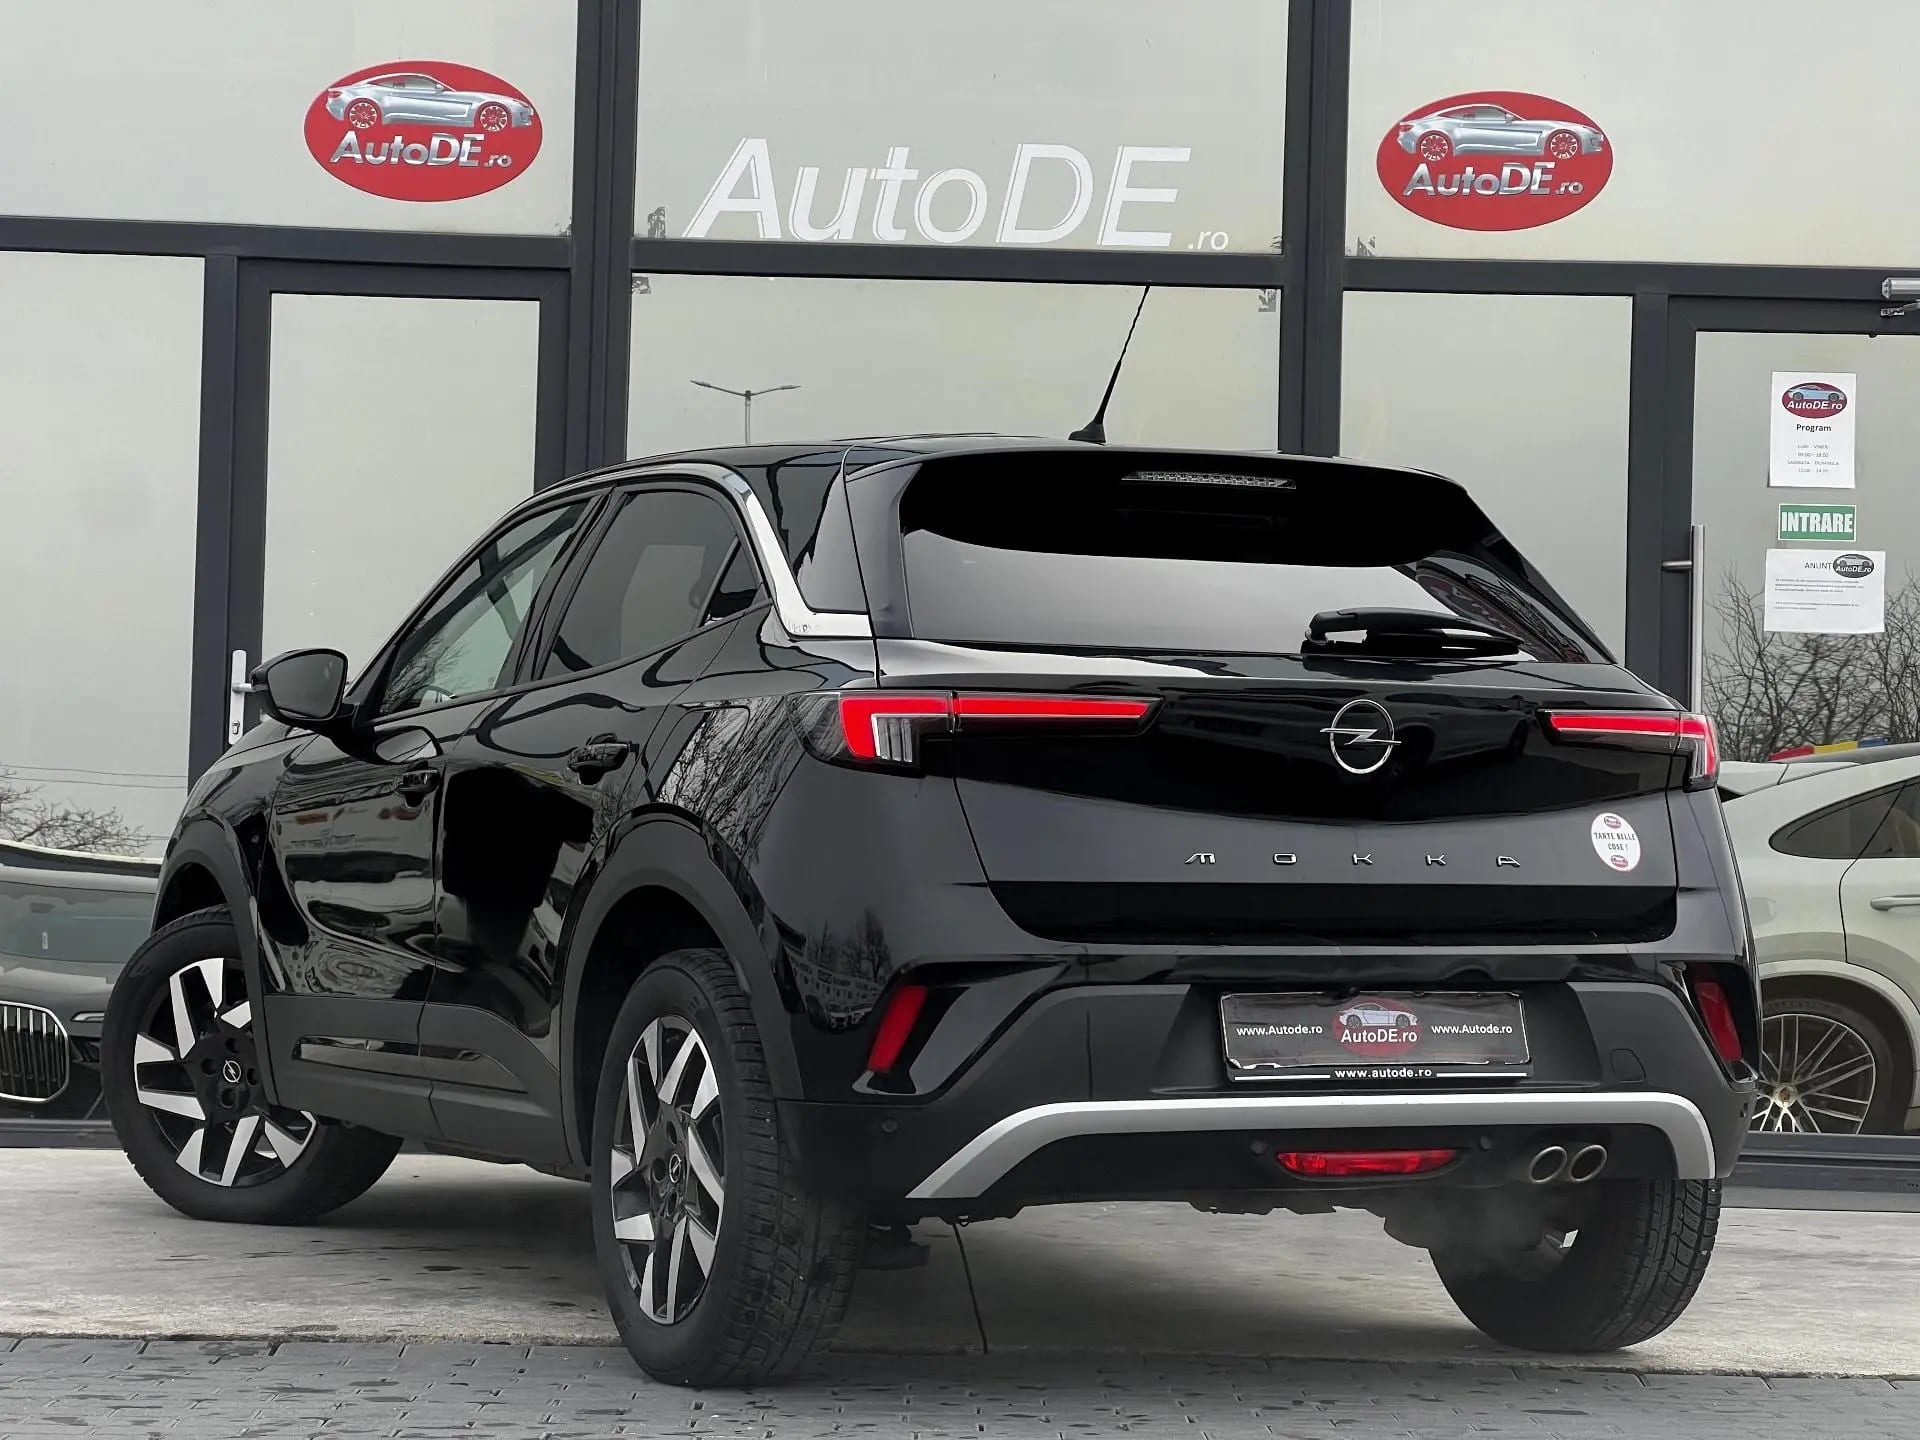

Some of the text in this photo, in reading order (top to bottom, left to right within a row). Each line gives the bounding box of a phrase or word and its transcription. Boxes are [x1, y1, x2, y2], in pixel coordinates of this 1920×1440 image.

[1786, 400, 1843, 410] AutoDE.ro
[1796, 423, 1832, 433] Program
[1781, 511, 1854, 533] INTRARE
[1593, 832, 1616, 840] TANTE
[1184, 852, 1521, 868] MOKKA
[1236, 1023, 1323, 1036] www.Autode.ro
[1431, 1023, 1513, 1035] www.Autode.ro
[1340, 1028, 1418, 1043] AutoDE.ro
[1334, 1067, 1433, 1079] www.autode.ro
